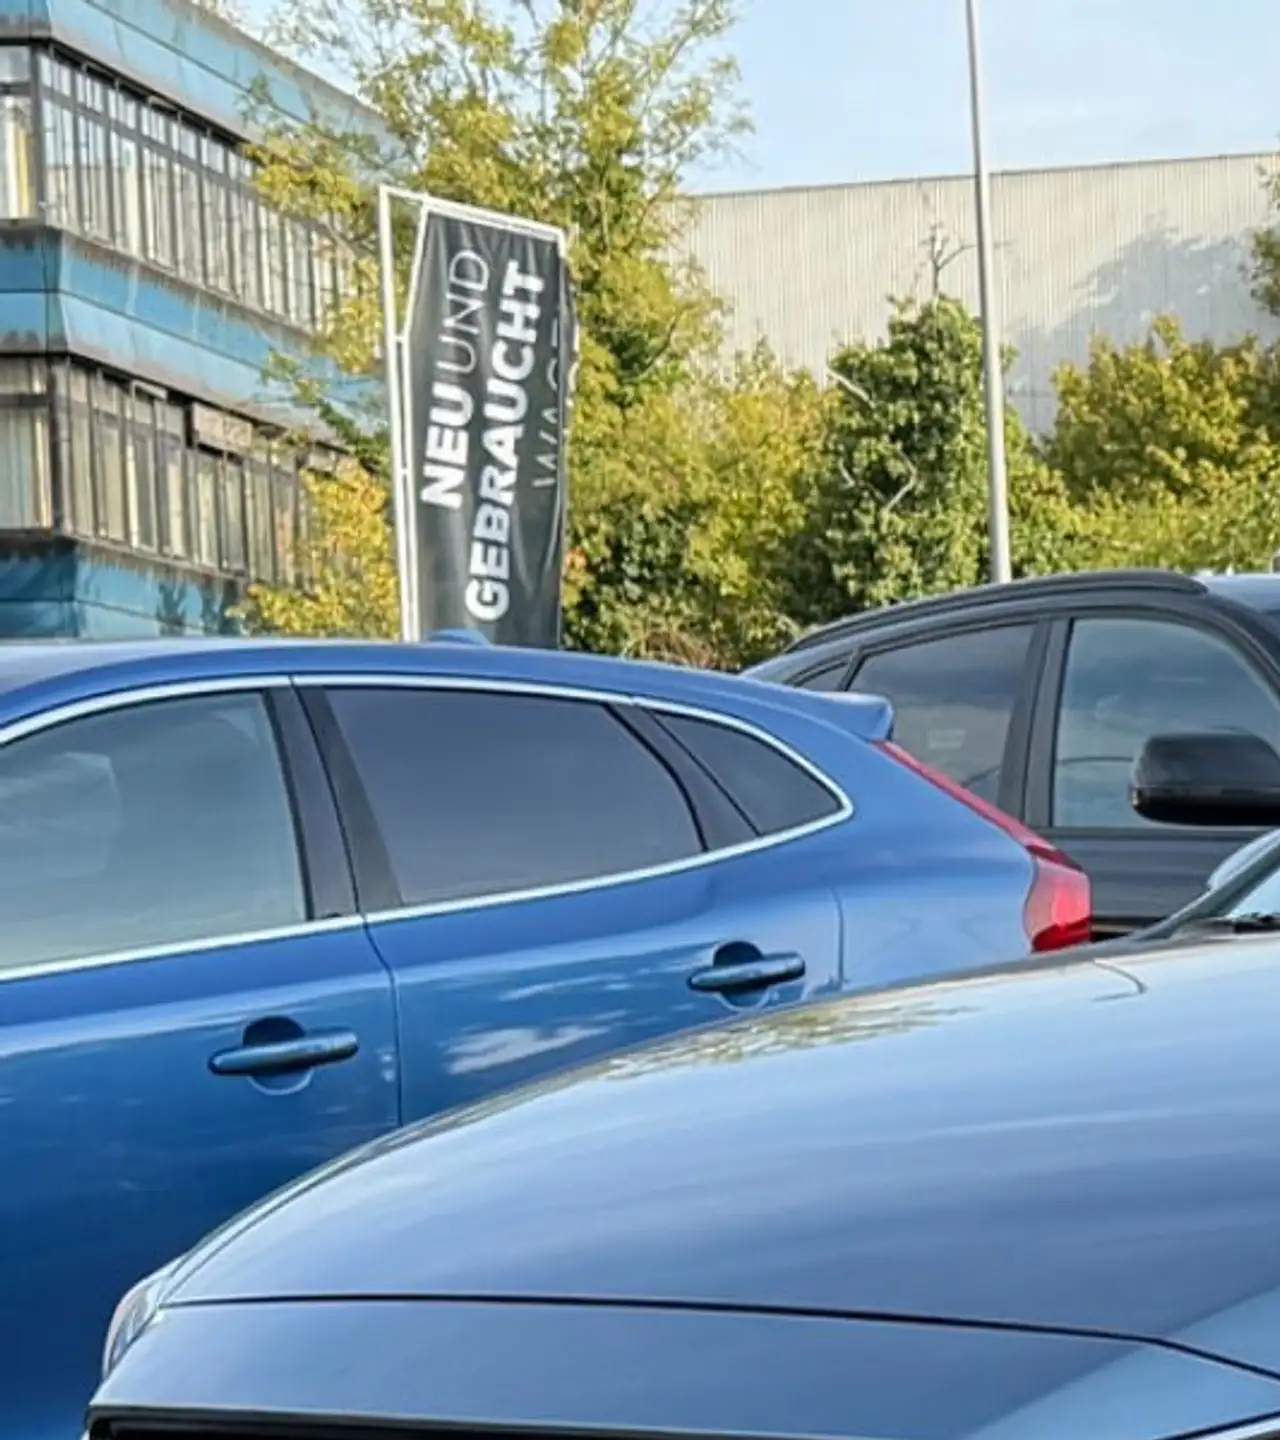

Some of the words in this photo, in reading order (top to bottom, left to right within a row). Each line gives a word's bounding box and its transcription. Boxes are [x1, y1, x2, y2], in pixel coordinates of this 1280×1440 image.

[435, 250, 490, 375] UND
[420, 380, 474, 510] NEU
[466, 258, 545, 622] GEBRAUCHT
